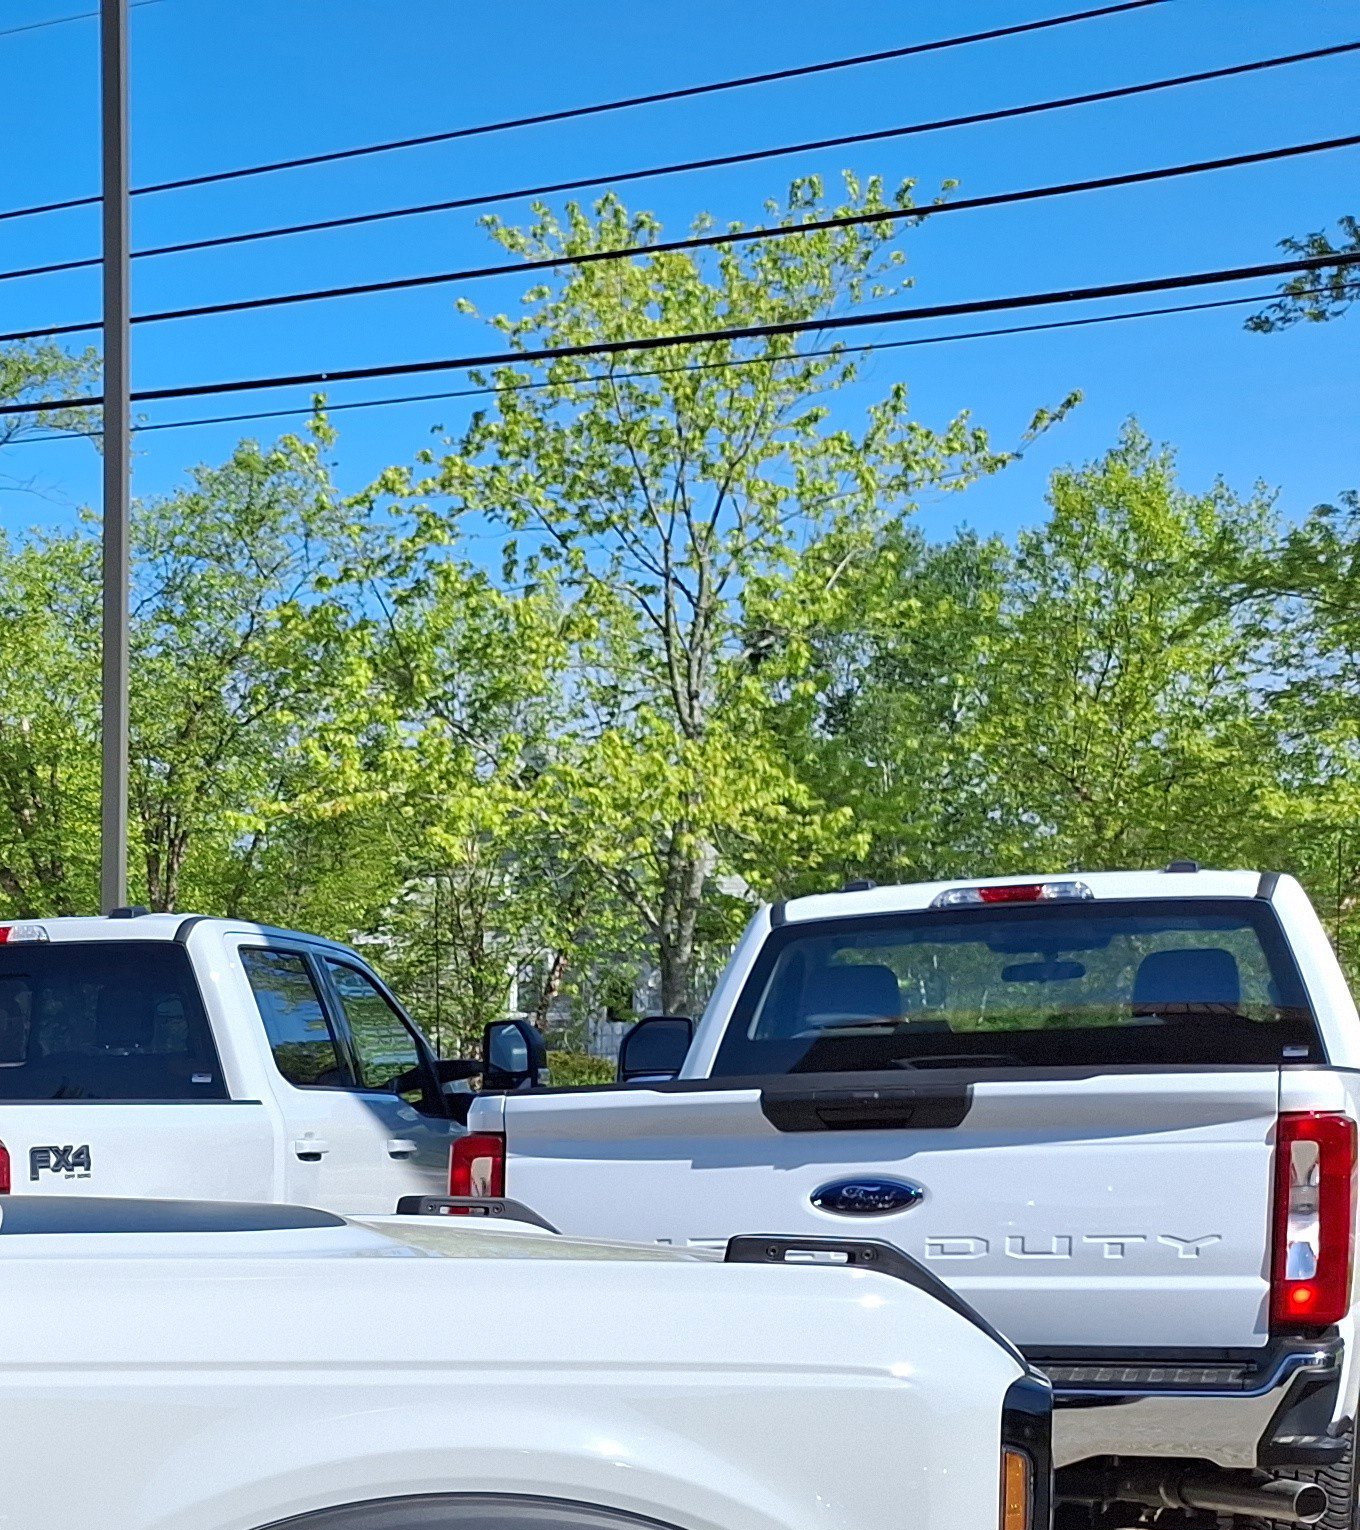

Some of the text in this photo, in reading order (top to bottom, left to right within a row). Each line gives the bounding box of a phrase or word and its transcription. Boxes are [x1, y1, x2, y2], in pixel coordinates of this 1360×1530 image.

[29, 1145, 92, 1182] FX4
[835, 1184, 897, 1210] Ford
[923, 1234, 1222, 1261] DUTY
